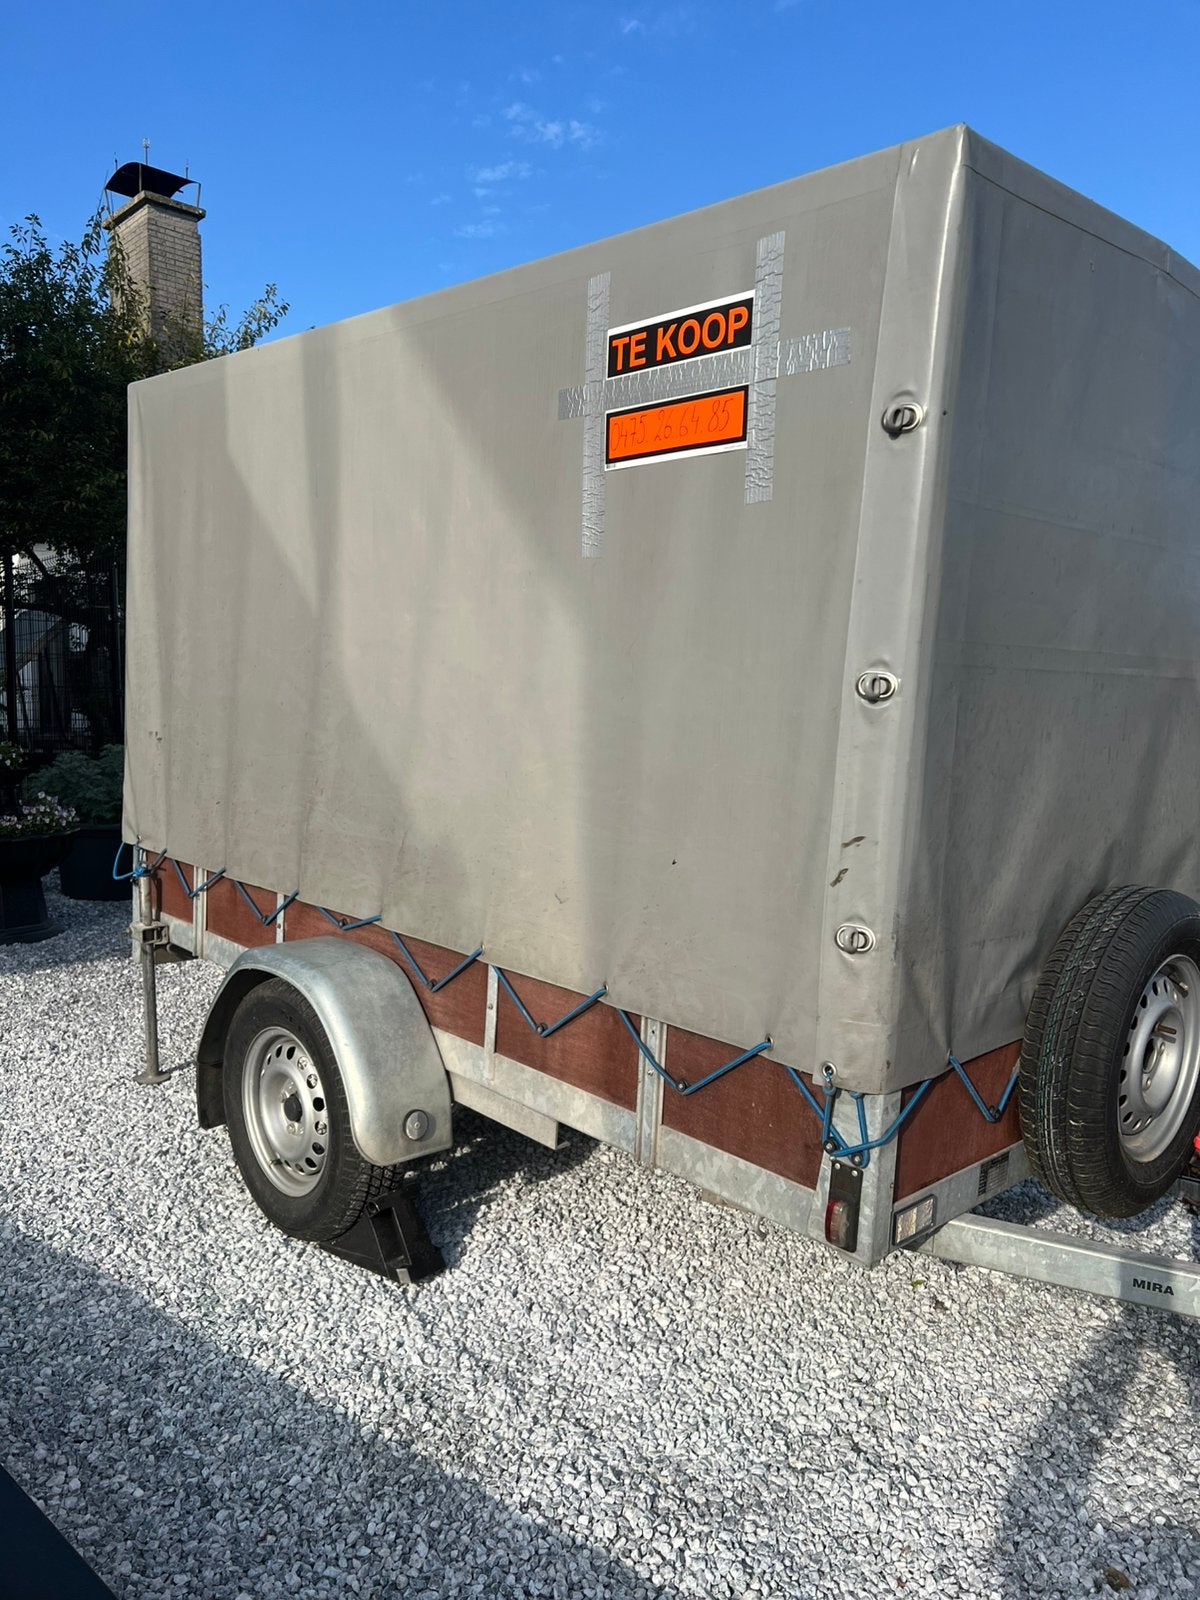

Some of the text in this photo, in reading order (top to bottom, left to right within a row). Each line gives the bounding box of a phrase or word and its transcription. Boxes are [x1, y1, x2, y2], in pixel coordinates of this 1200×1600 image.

[611, 306, 749, 371] TE KOOP
[1132, 1278, 1175, 1296] MIRA
